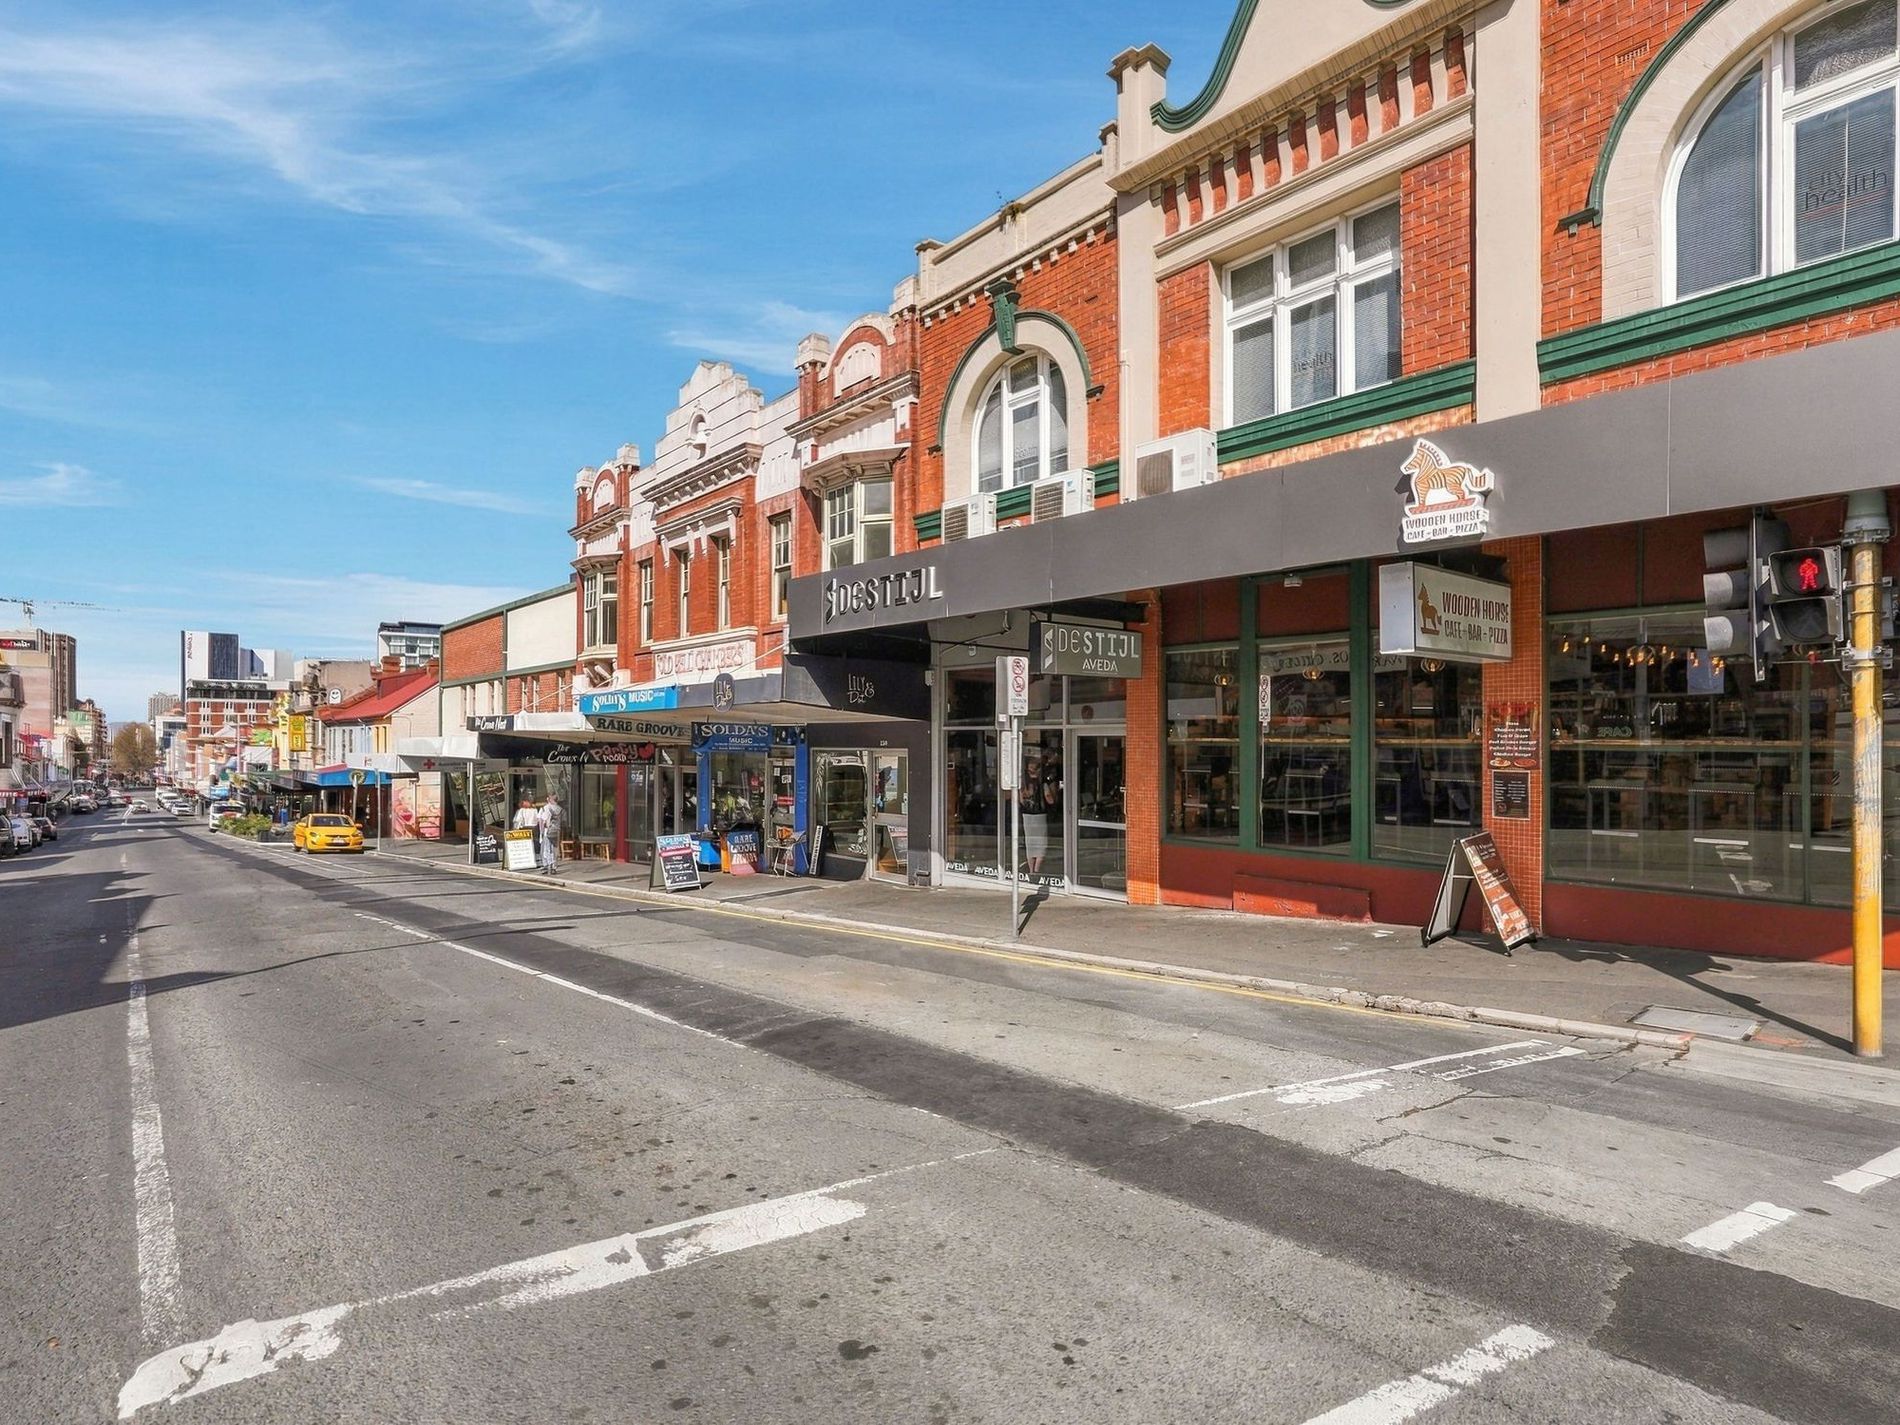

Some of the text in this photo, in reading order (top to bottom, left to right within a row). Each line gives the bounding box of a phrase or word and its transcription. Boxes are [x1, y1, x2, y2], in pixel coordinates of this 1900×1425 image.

[1405, 509, 1481, 530] WOODEN HORSE
[1407, 522, 1479, 541] CAFE BAR PIZZA
[1442, 591, 1509, 624] WOODEN HORSE
[1444, 619, 1508, 646] CAFE BAR PIZZA
[1057, 627, 1140, 660] DESTIJL
[1082, 659, 1120, 673] AVEDA
[628, 690, 654, 703] MUSIC
[597, 718, 685, 737] RARE GROOVE
[701, 724, 769, 737] SOLDA'S
[945, 862, 969, 872] AVEDA
[975, 866, 999, 877] AVEDA
[1038, 876, 1066, 888] AVEDA
